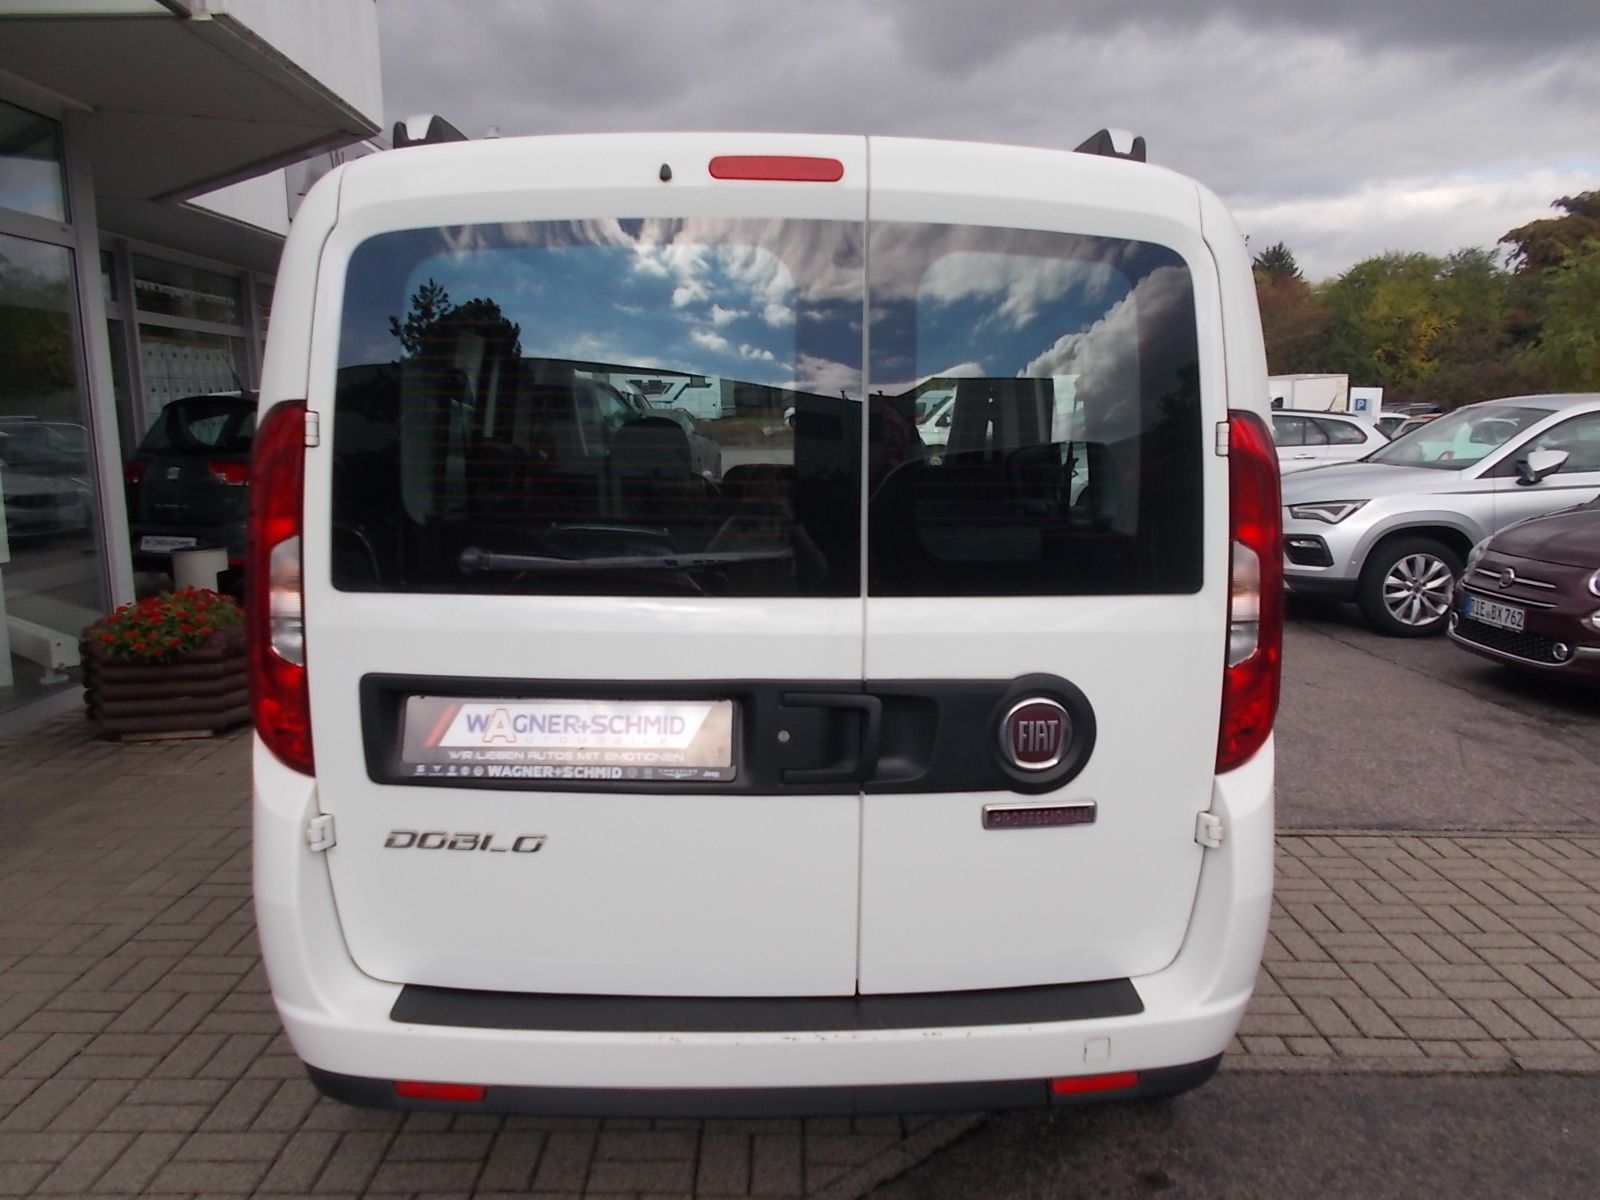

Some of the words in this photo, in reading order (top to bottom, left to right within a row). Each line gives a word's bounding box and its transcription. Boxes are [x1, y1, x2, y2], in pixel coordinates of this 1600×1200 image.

[1505, 609, 1523, 627] 762
[466, 708, 685, 743] WAGNER+SCHMID
[1018, 720, 1059, 752] FIAT
[448, 750, 472, 760] WIR
[476, 751, 523, 761] LIEBEN
[528, 751, 574, 761] AUTOS
[577, 752, 600, 761] MIT
[487, 764, 623, 779] WAGNER+SCHMID
